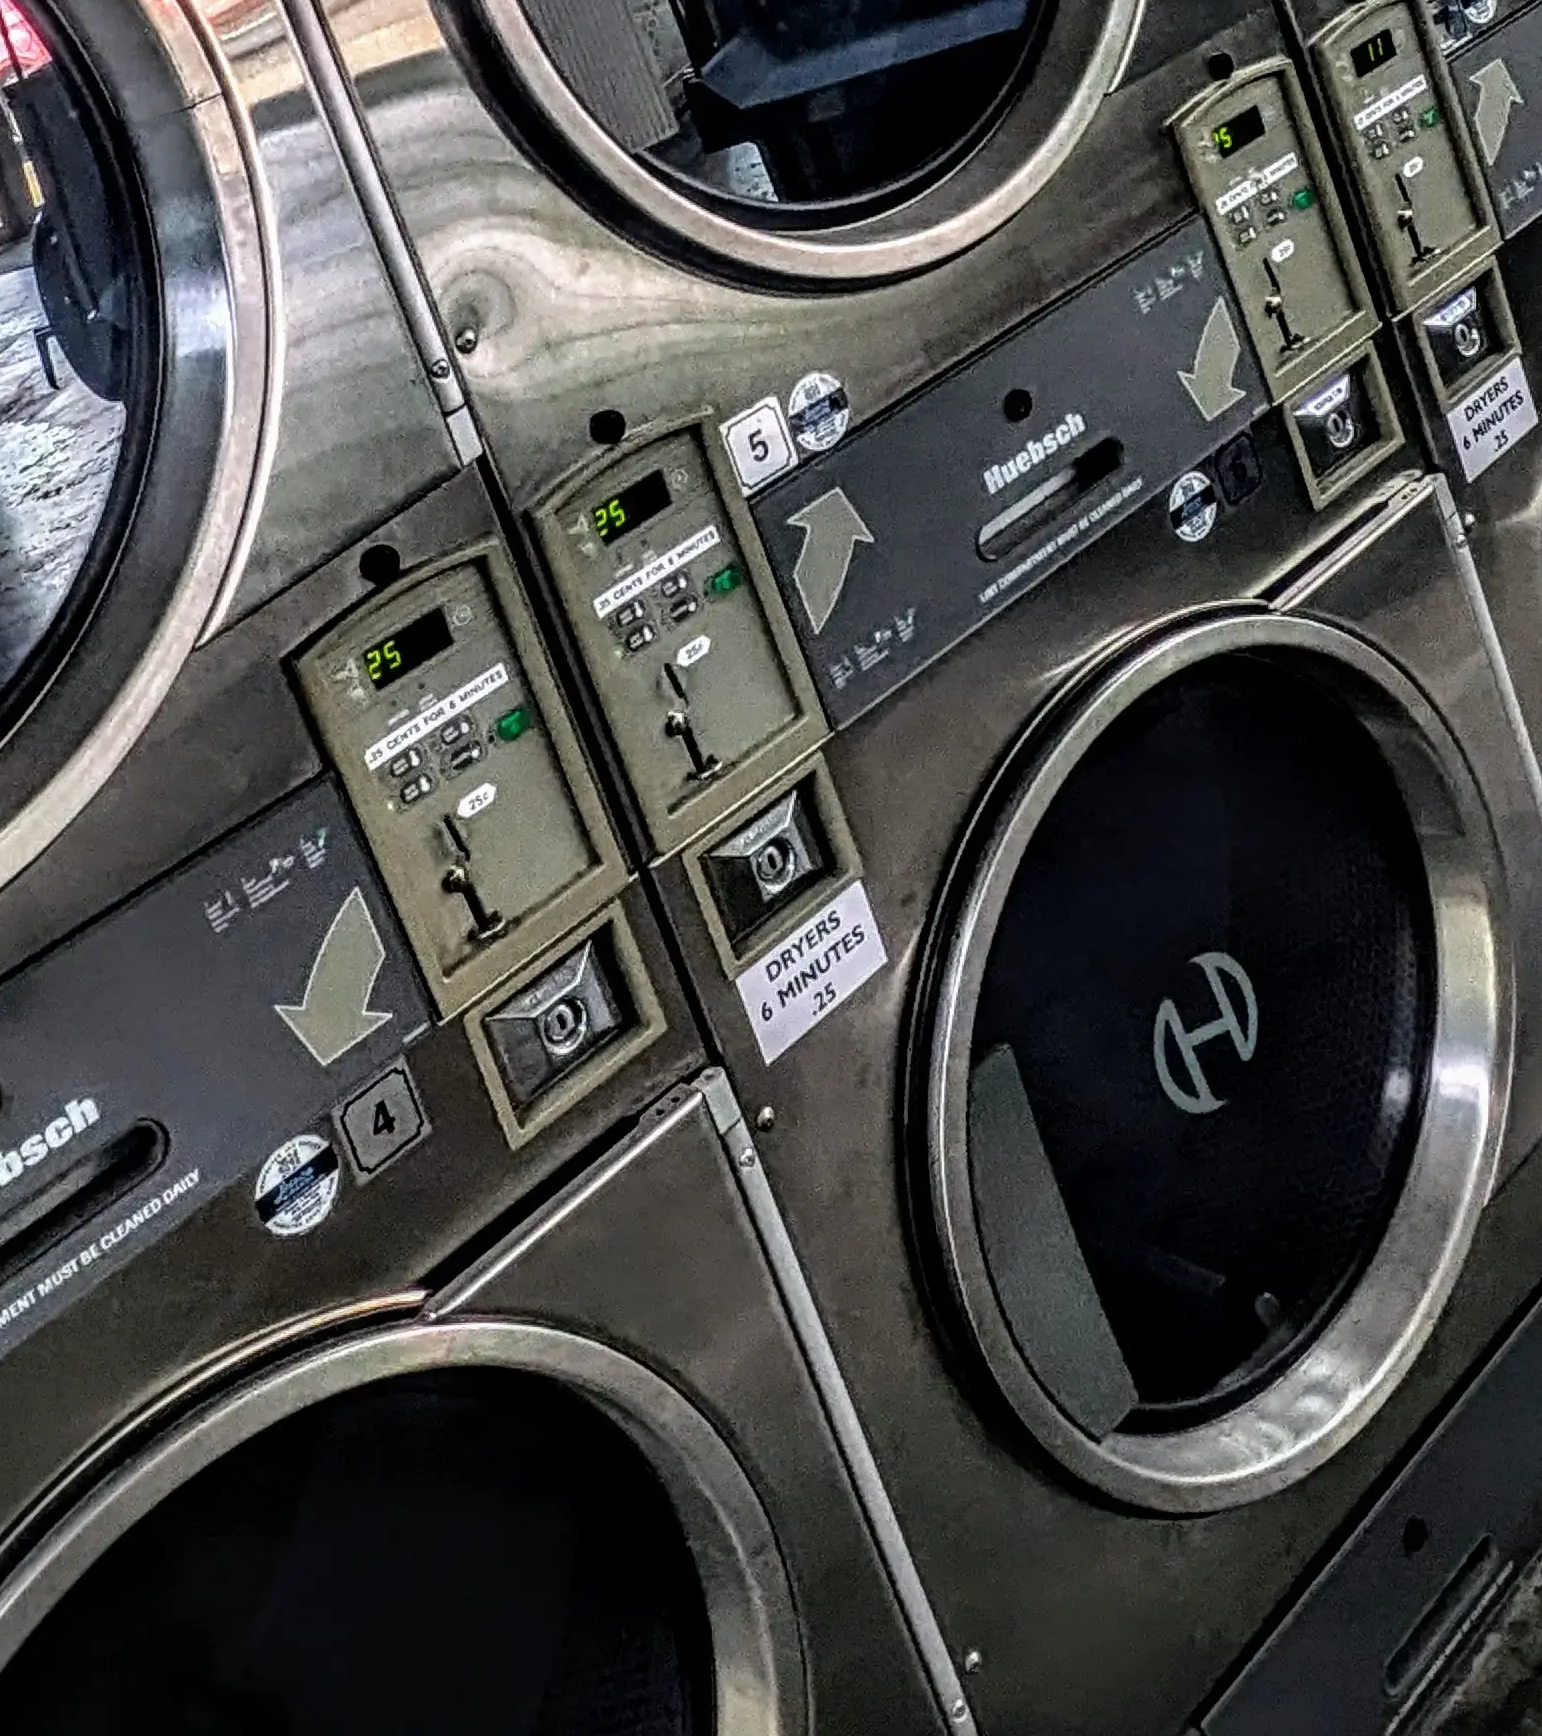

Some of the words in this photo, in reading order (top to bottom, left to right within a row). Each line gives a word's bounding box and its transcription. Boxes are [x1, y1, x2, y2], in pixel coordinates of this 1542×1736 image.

[1463, 376, 1509, 421] DRYERS
[1463, 436, 1471, 450] 6
[1472, 390, 1524, 442] MINUTES
[750, 431, 769, 462] 5
[983, 413, 1087, 494] Huebsch
[595, 499, 626, 537] 25
[367, 640, 402, 680] 25
[386, 725, 421, 750] CENTS
[423, 707, 446, 726] FOR
[765, 910, 842, 983] DRYERS
[761, 1001, 773, 1022] 6
[777, 924, 865, 1008] MINUTES
[812, 982, 838, 1016] .25
[370, 1100, 396, 1139] 4
[36, 1258, 82, 1298] MUST
[79, 1244, 102, 1266] BE
[100, 1198, 162, 1250] CLEANED
[162, 1168, 201, 1205] DAILY
